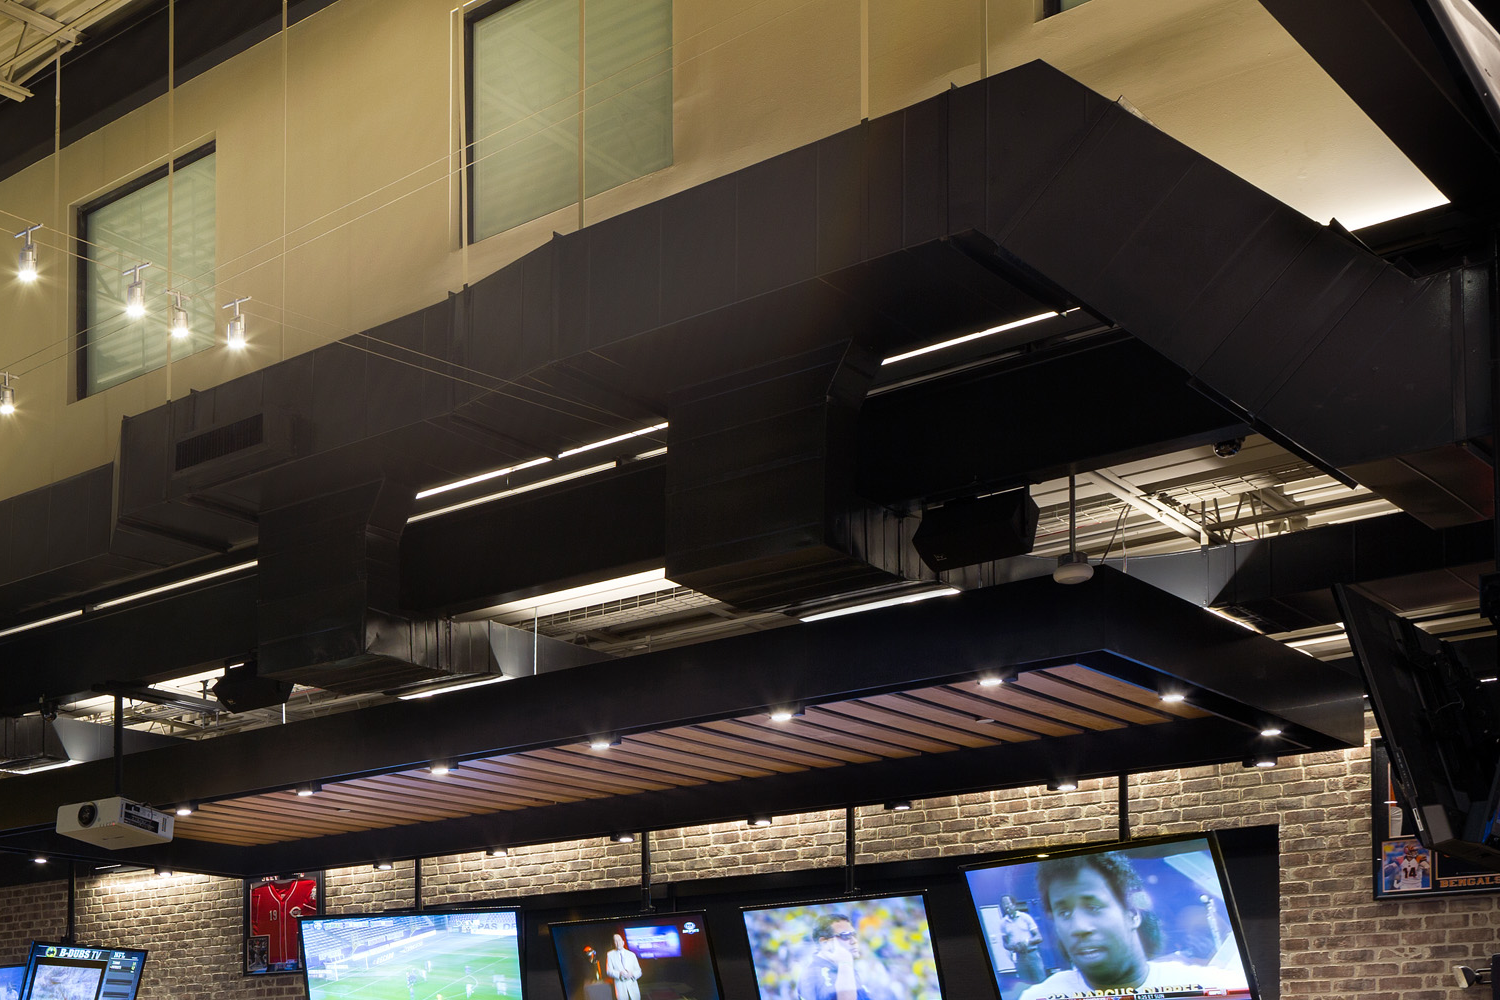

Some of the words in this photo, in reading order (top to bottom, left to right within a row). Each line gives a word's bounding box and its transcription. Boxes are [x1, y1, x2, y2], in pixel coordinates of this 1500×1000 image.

[1403, 866, 1418, 879] 14
[59, 949, 91, 959] B-DUBS
[91, 951, 101, 959] TV
